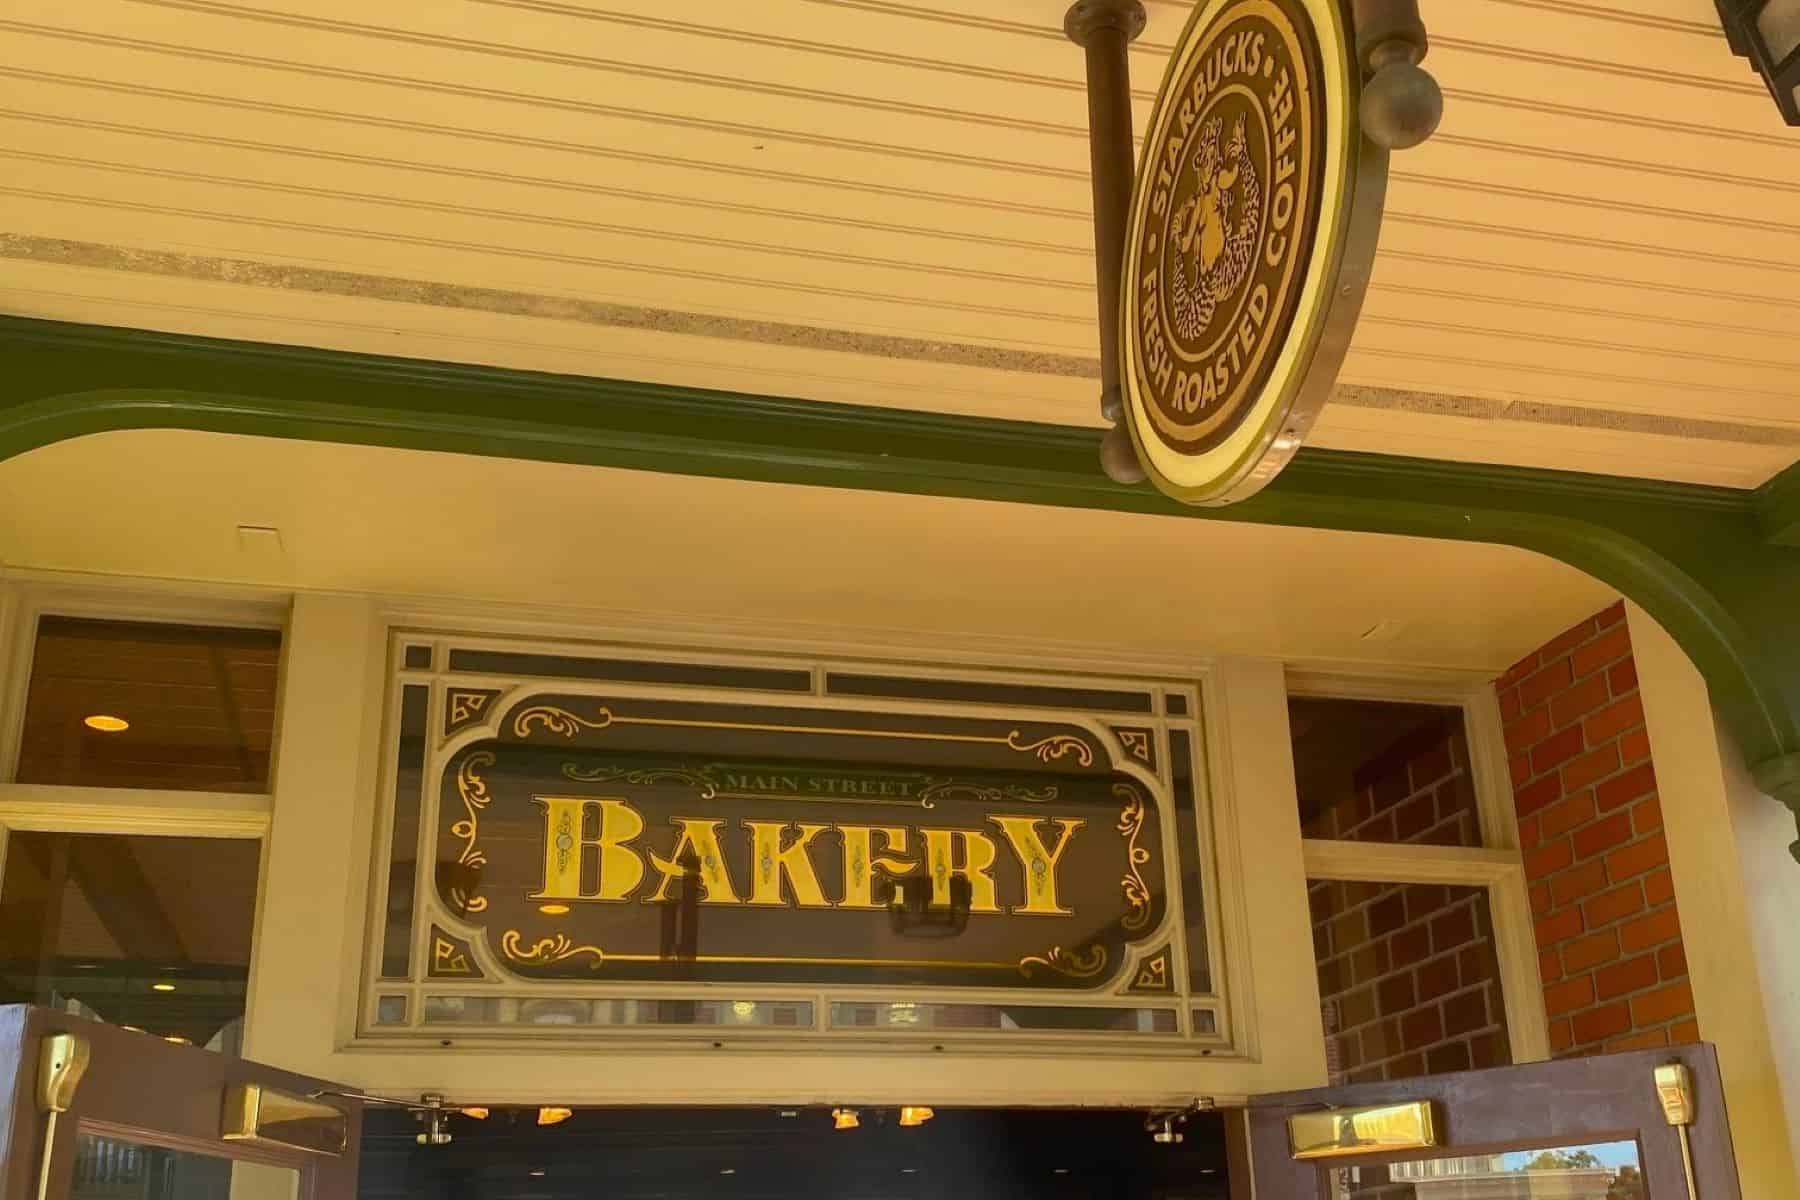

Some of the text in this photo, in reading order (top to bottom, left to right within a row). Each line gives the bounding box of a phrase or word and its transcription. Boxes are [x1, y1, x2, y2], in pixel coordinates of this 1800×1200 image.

[1152, 30, 1265, 218] STARBUCKS
[1142, 67, 1297, 414] FRESH ROASTED COFFEE
[527, 796, 1087, 916] BAKERY
[726, 774, 913, 796] MAIN STREET
